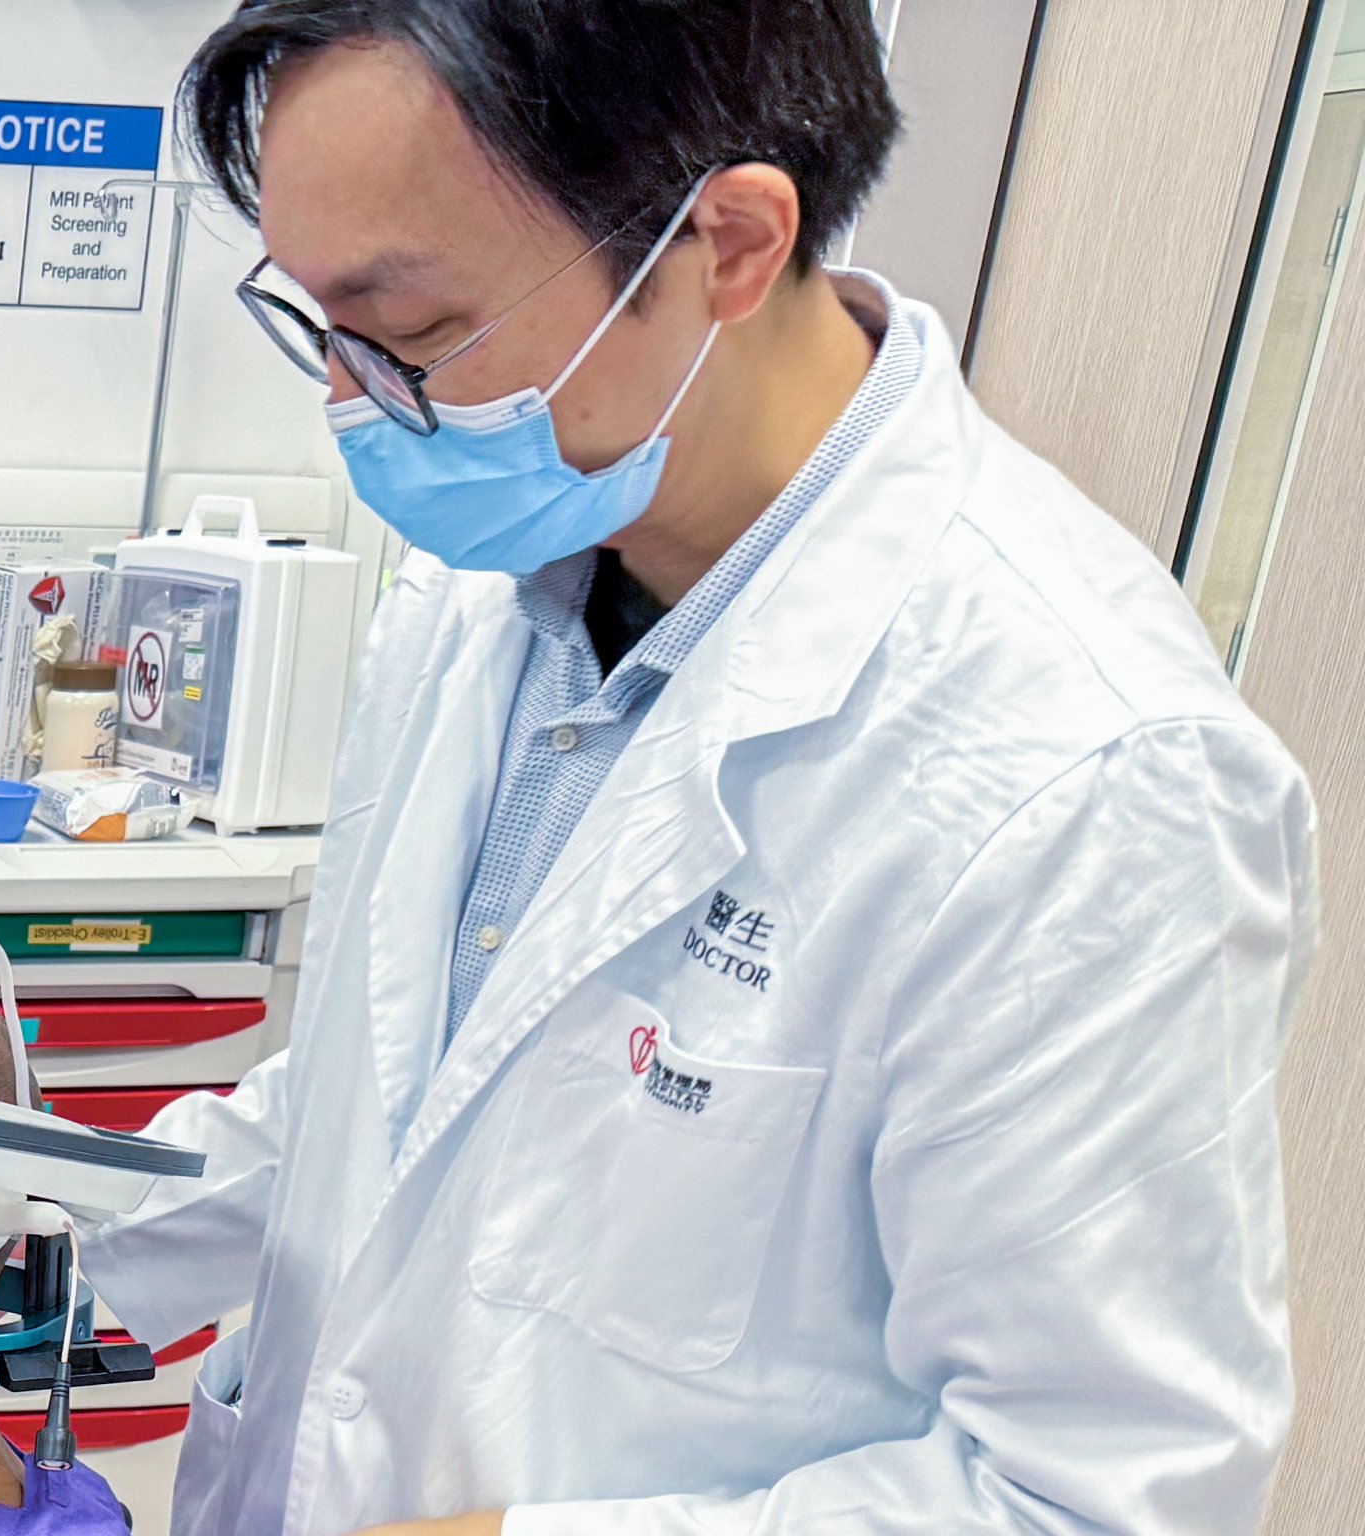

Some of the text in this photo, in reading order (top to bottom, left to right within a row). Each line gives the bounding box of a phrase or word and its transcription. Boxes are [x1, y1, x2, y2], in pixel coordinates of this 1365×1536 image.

[49, 191, 79, 208] MRI
[51, 214, 127, 237] Screening
[71, 240, 102, 256] and
[40, 262, 127, 282] Preparation
[705, 889, 775, 952] 醫生
[33, 927, 147, 941] E-Trolley Checklist
[682, 926, 772, 993] DOCTOR
